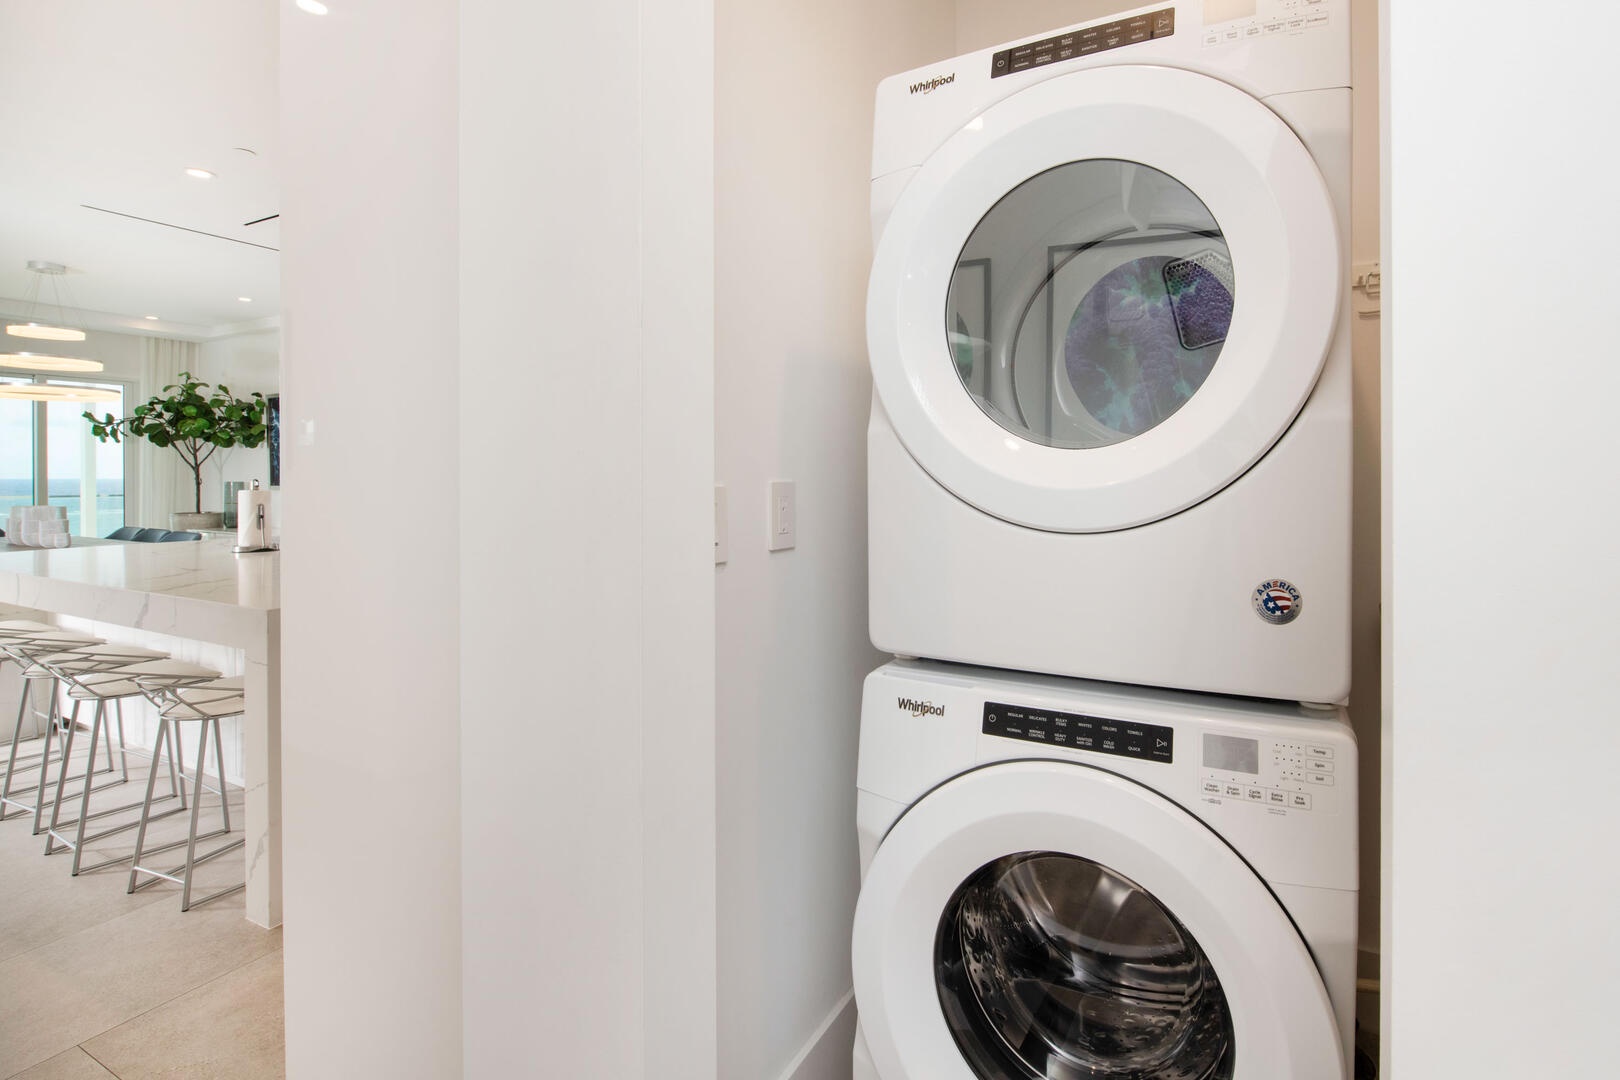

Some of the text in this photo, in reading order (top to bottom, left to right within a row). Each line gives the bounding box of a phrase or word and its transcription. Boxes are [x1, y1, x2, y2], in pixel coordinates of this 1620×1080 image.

[909, 73, 955, 95] Whirlpool
[1256, 580, 1300, 602] AMERICA
[898, 697, 945, 717] Whirlpool
[1313, 748, 1327, 756] Temp
